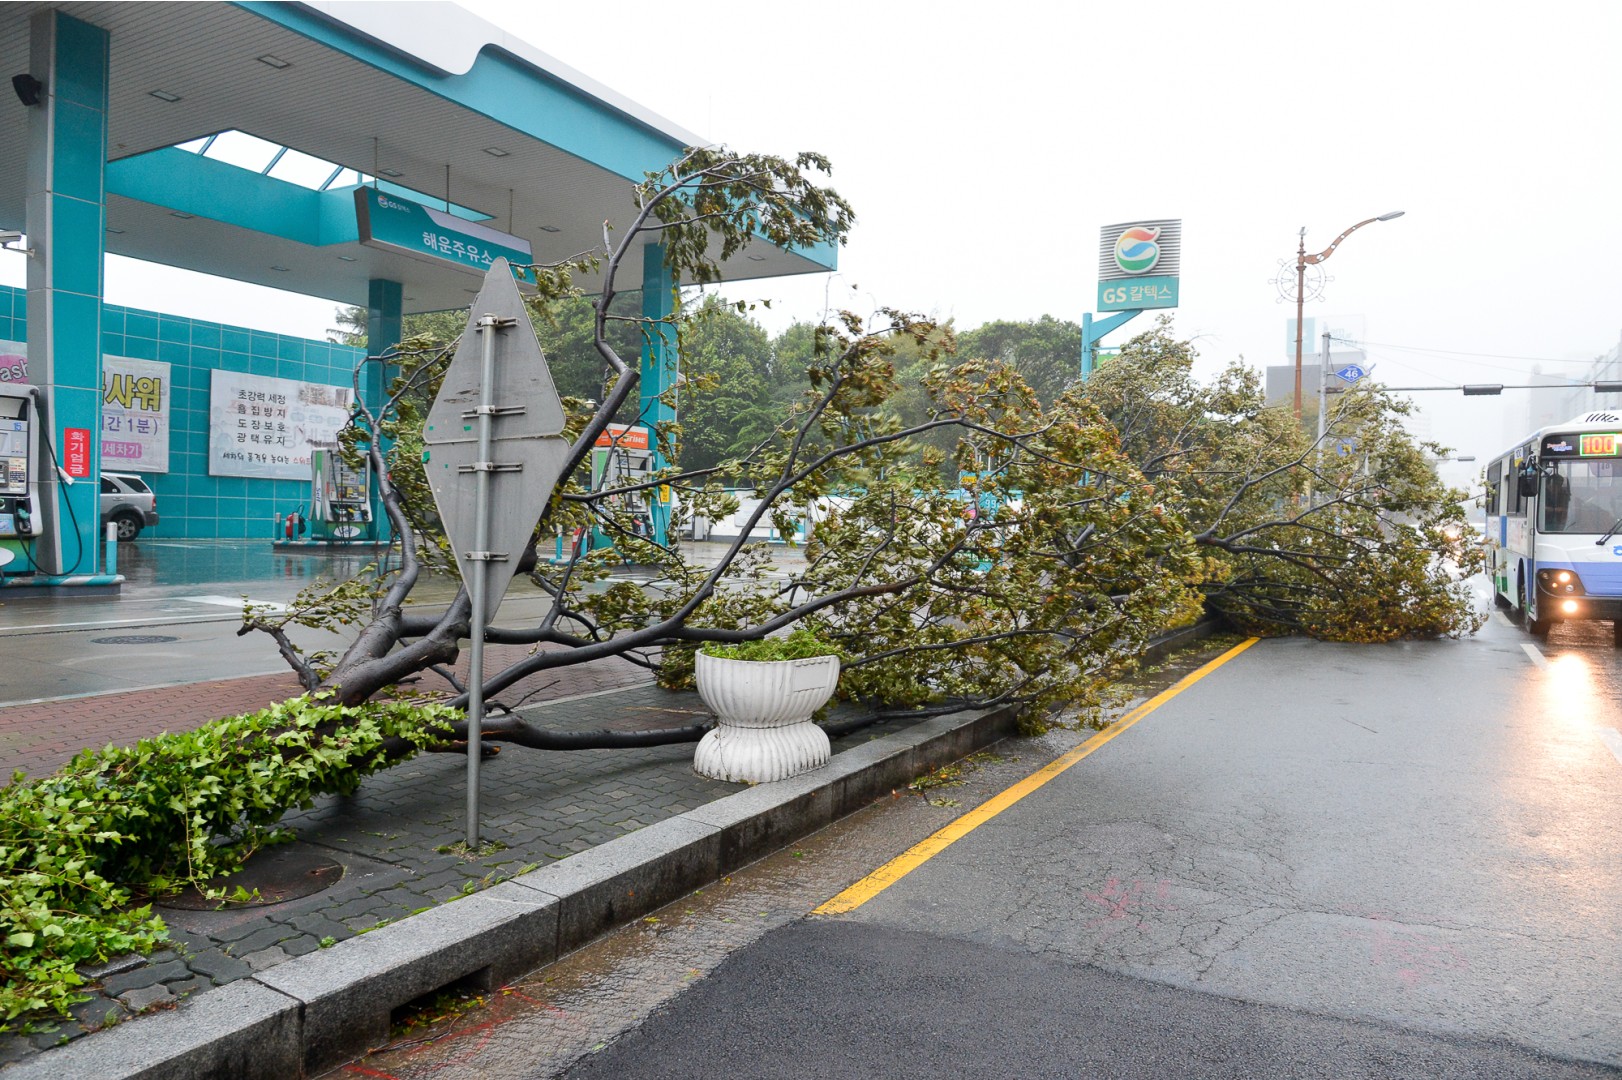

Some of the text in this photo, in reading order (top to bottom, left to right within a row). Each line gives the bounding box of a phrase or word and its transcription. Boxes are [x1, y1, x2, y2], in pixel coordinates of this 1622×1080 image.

[422, 231, 494, 265] 해운주유소
[1103, 285, 1172, 304] GS 칼텍스
[1344, 370, 1359, 378] 46
[238, 390, 286, 405] 초강력 세정
[70, 431, 85, 475] 화기엄금
[104, 443, 140, 458] 세차기
[1583, 436, 1615, 454] 100
